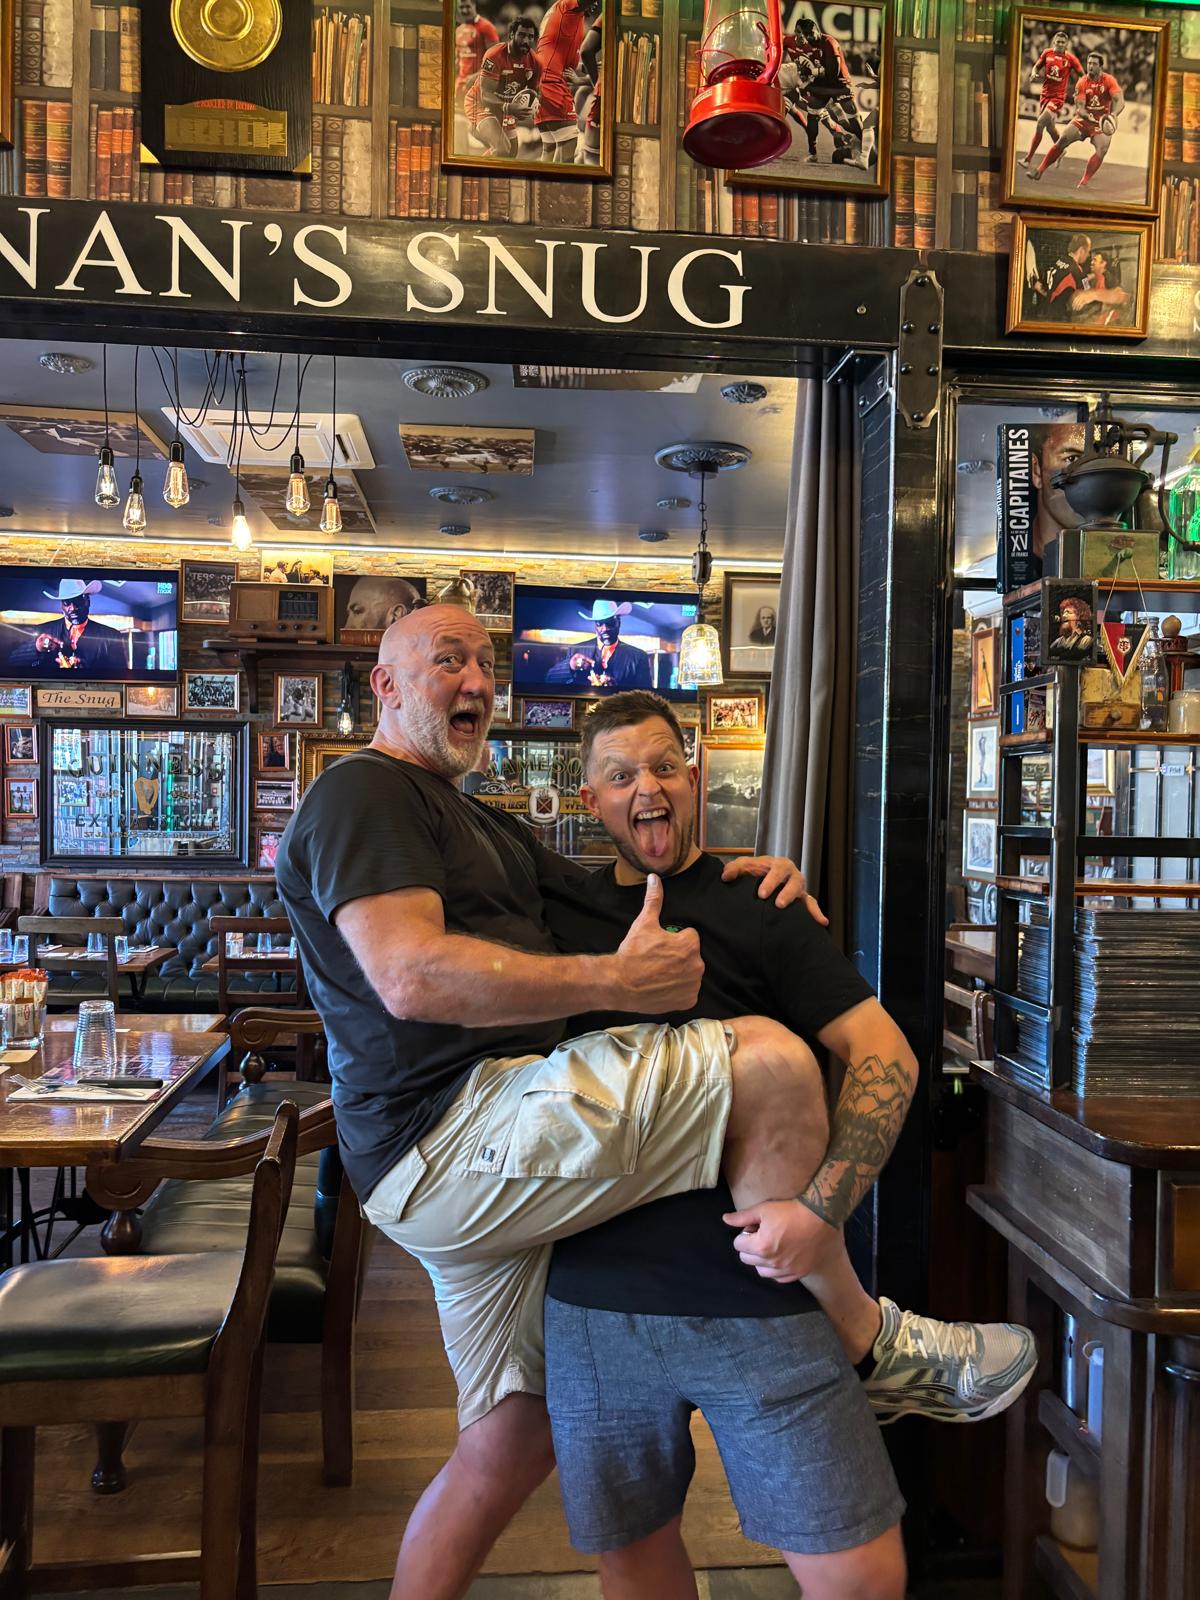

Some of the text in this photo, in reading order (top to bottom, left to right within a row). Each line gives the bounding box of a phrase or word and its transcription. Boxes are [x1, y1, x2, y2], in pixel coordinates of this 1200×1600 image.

[407, 232, 752, 329] SNUG
[1008, 429, 1029, 530] CAPITAINES
[1010, 534, 1028, 552] XV
[42, 691, 115, 708] The Snug
[68, 752, 224, 780] GUINNESS
[487, 754, 584, 779] JAMESO
[75, 814, 140, 828] EXTRA
